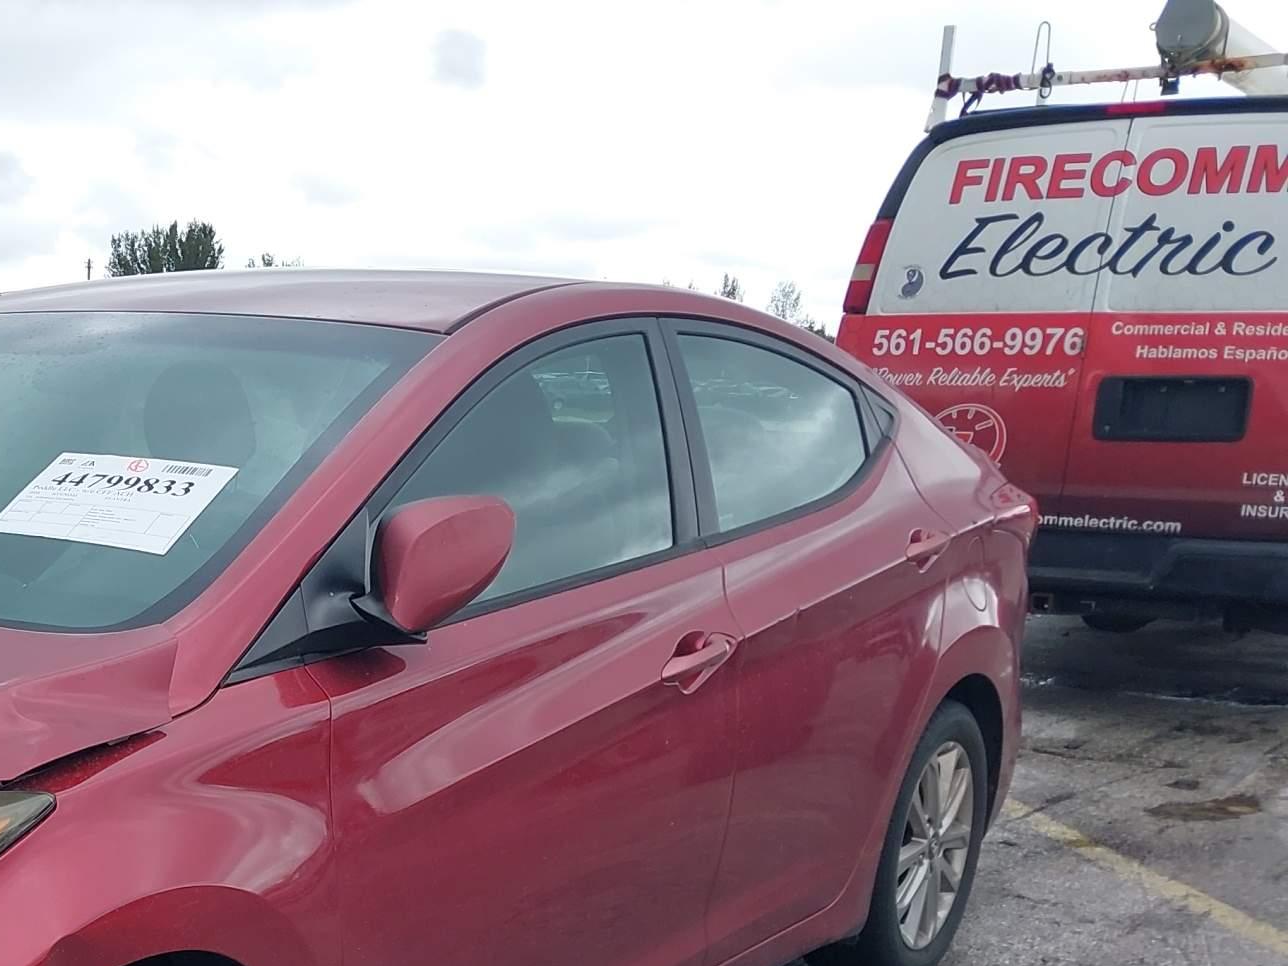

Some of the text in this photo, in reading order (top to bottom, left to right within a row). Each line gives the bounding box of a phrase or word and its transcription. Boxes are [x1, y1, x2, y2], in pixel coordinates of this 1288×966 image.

[949, 144, 1288, 204] FIRECOMM
[939, 211, 1277, 280] Electric
[872, 327, 1084, 356] 561-566-9976
[1112, 321, 1210, 335] Commercial
[1215, 322, 1227, 336] &
[1136, 345, 1218, 359] Hablamos
[927, 366, 995, 387] Reliable
[999, 367, 1075, 392] Experts"
[51, 471, 195, 497] 44799833
[1273, 490, 1285, 502] &
